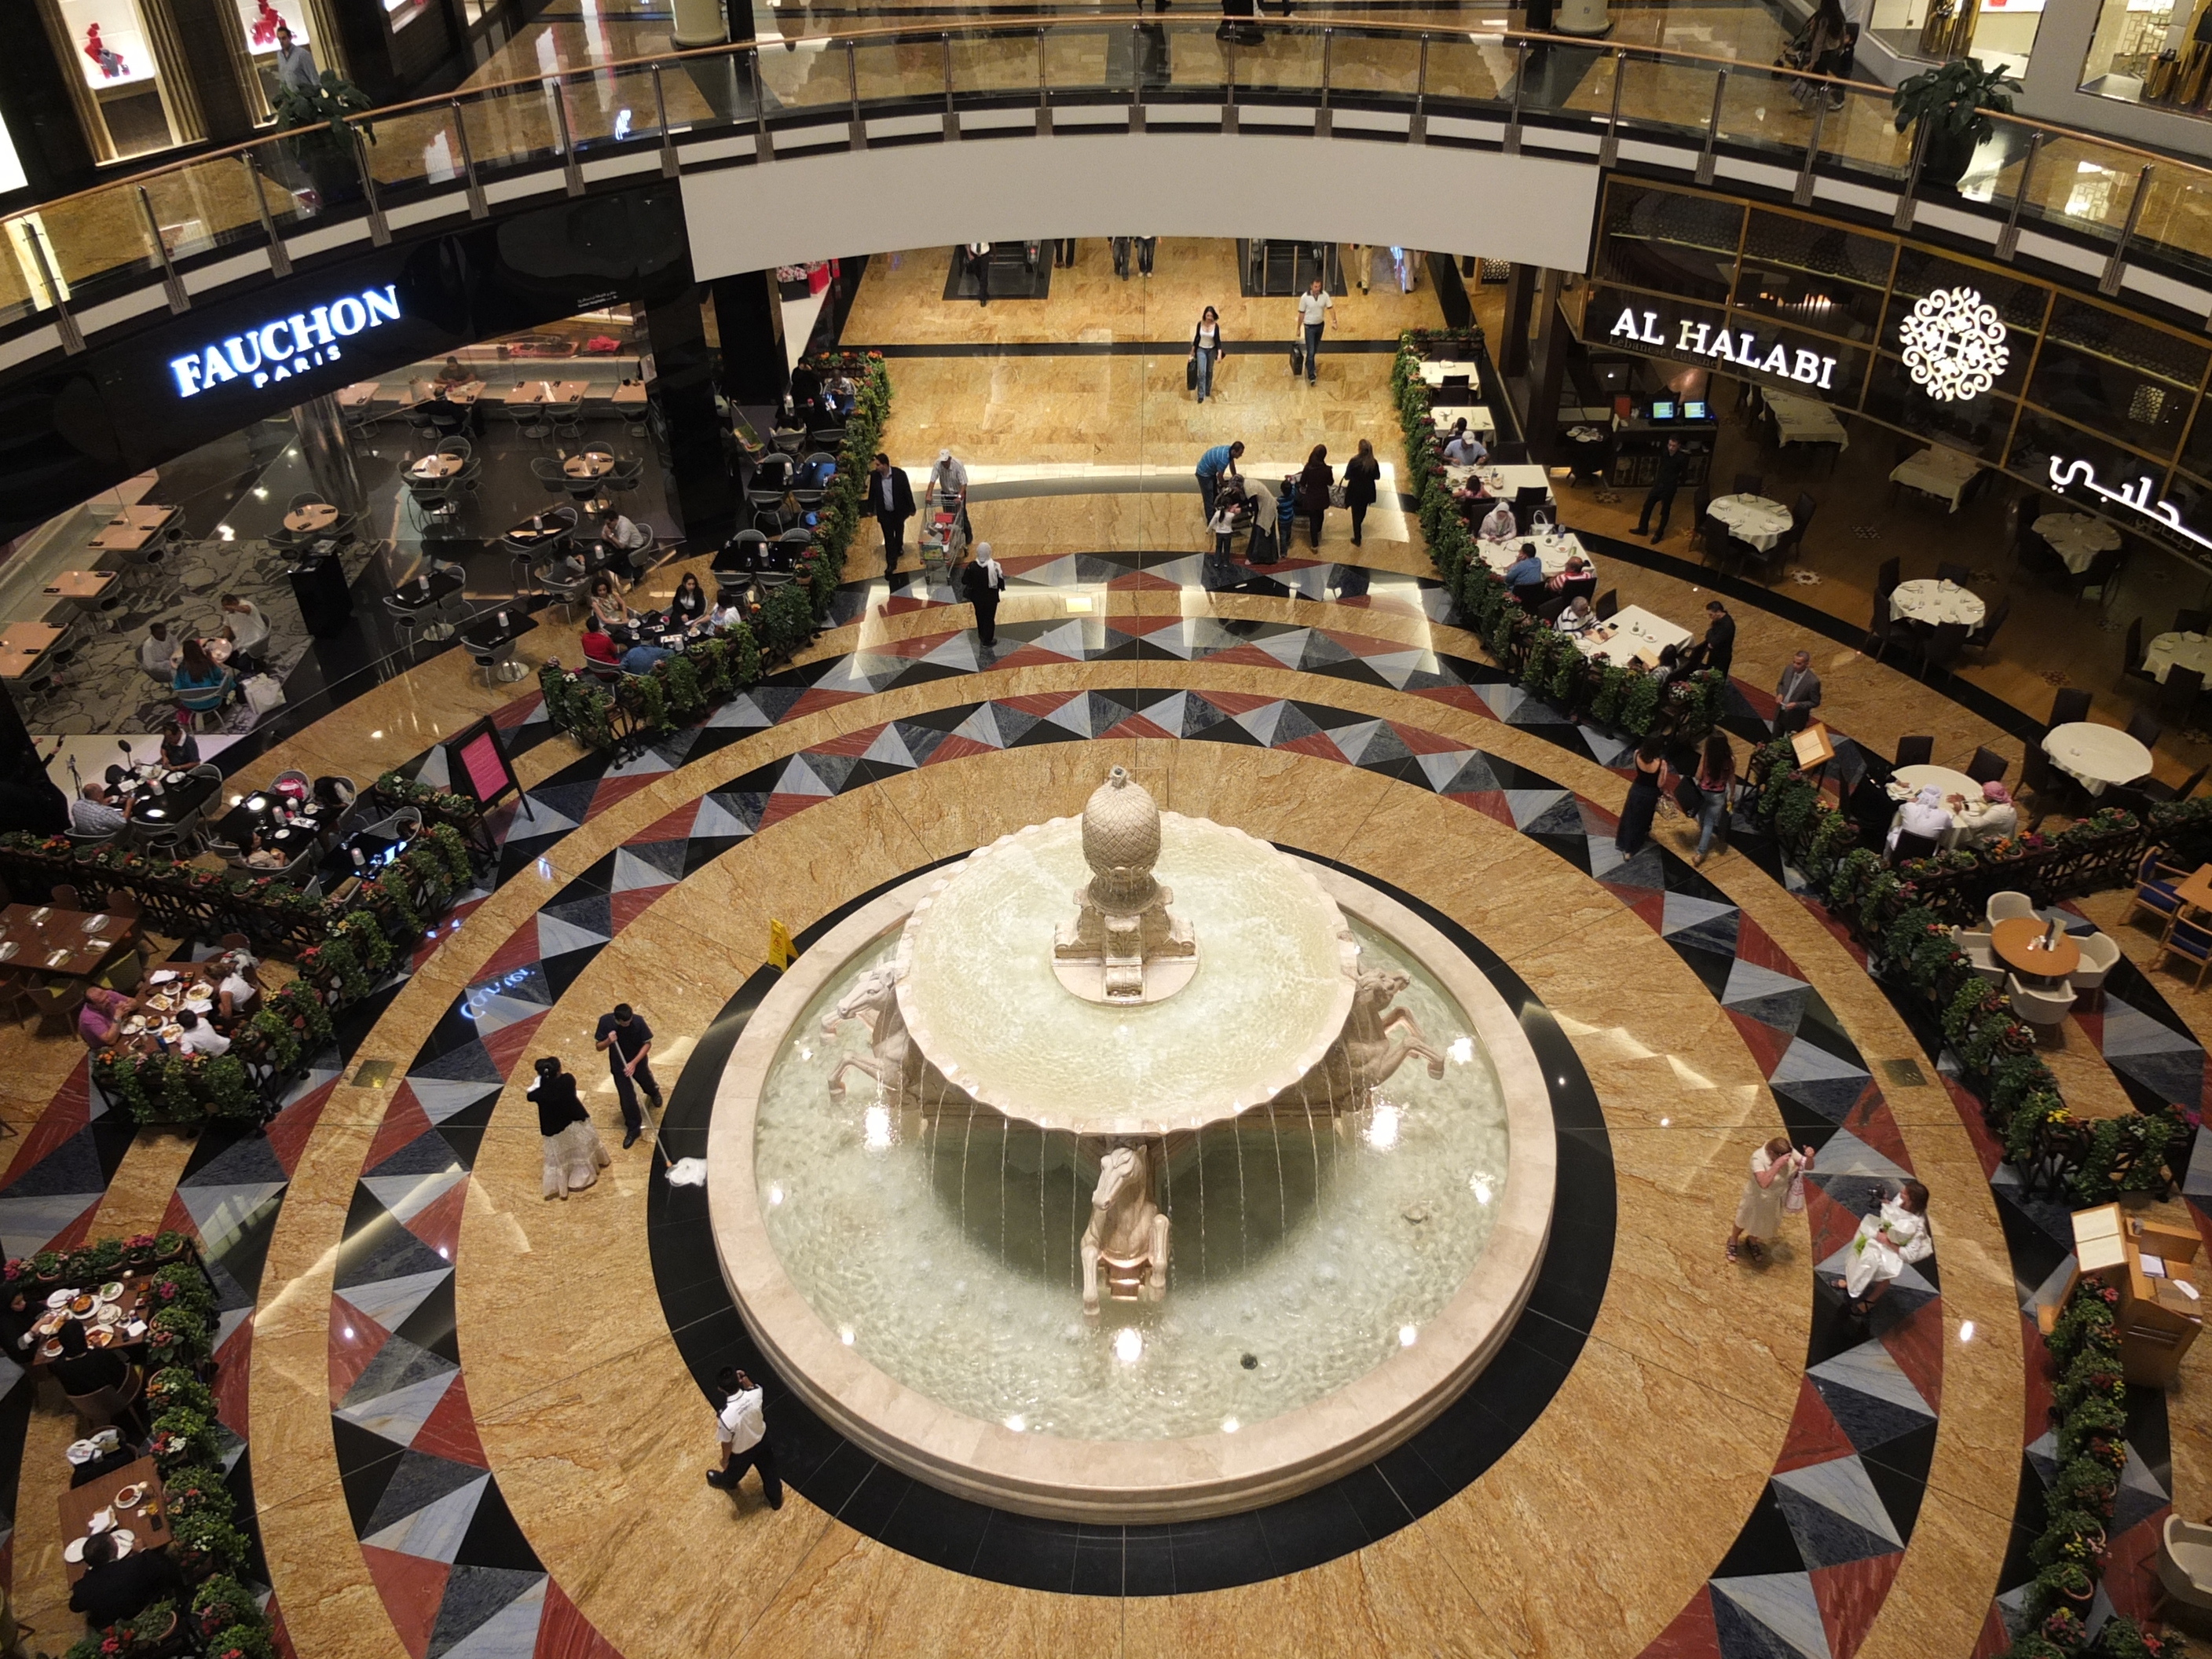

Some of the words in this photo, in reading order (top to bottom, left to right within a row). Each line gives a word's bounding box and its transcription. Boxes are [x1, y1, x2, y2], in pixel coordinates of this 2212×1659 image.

[170, 284, 401, 398] FAUCHON
[253, 345, 342, 388] PARIS
[1608, 335, 1667, 357] Lebanese
[1670, 346, 1718, 368] Cuisine
[1610, 308, 1664, 346] AL
[1675, 319, 1837, 390] HALABI
[2049, 455, 2212, 550] حلبي
